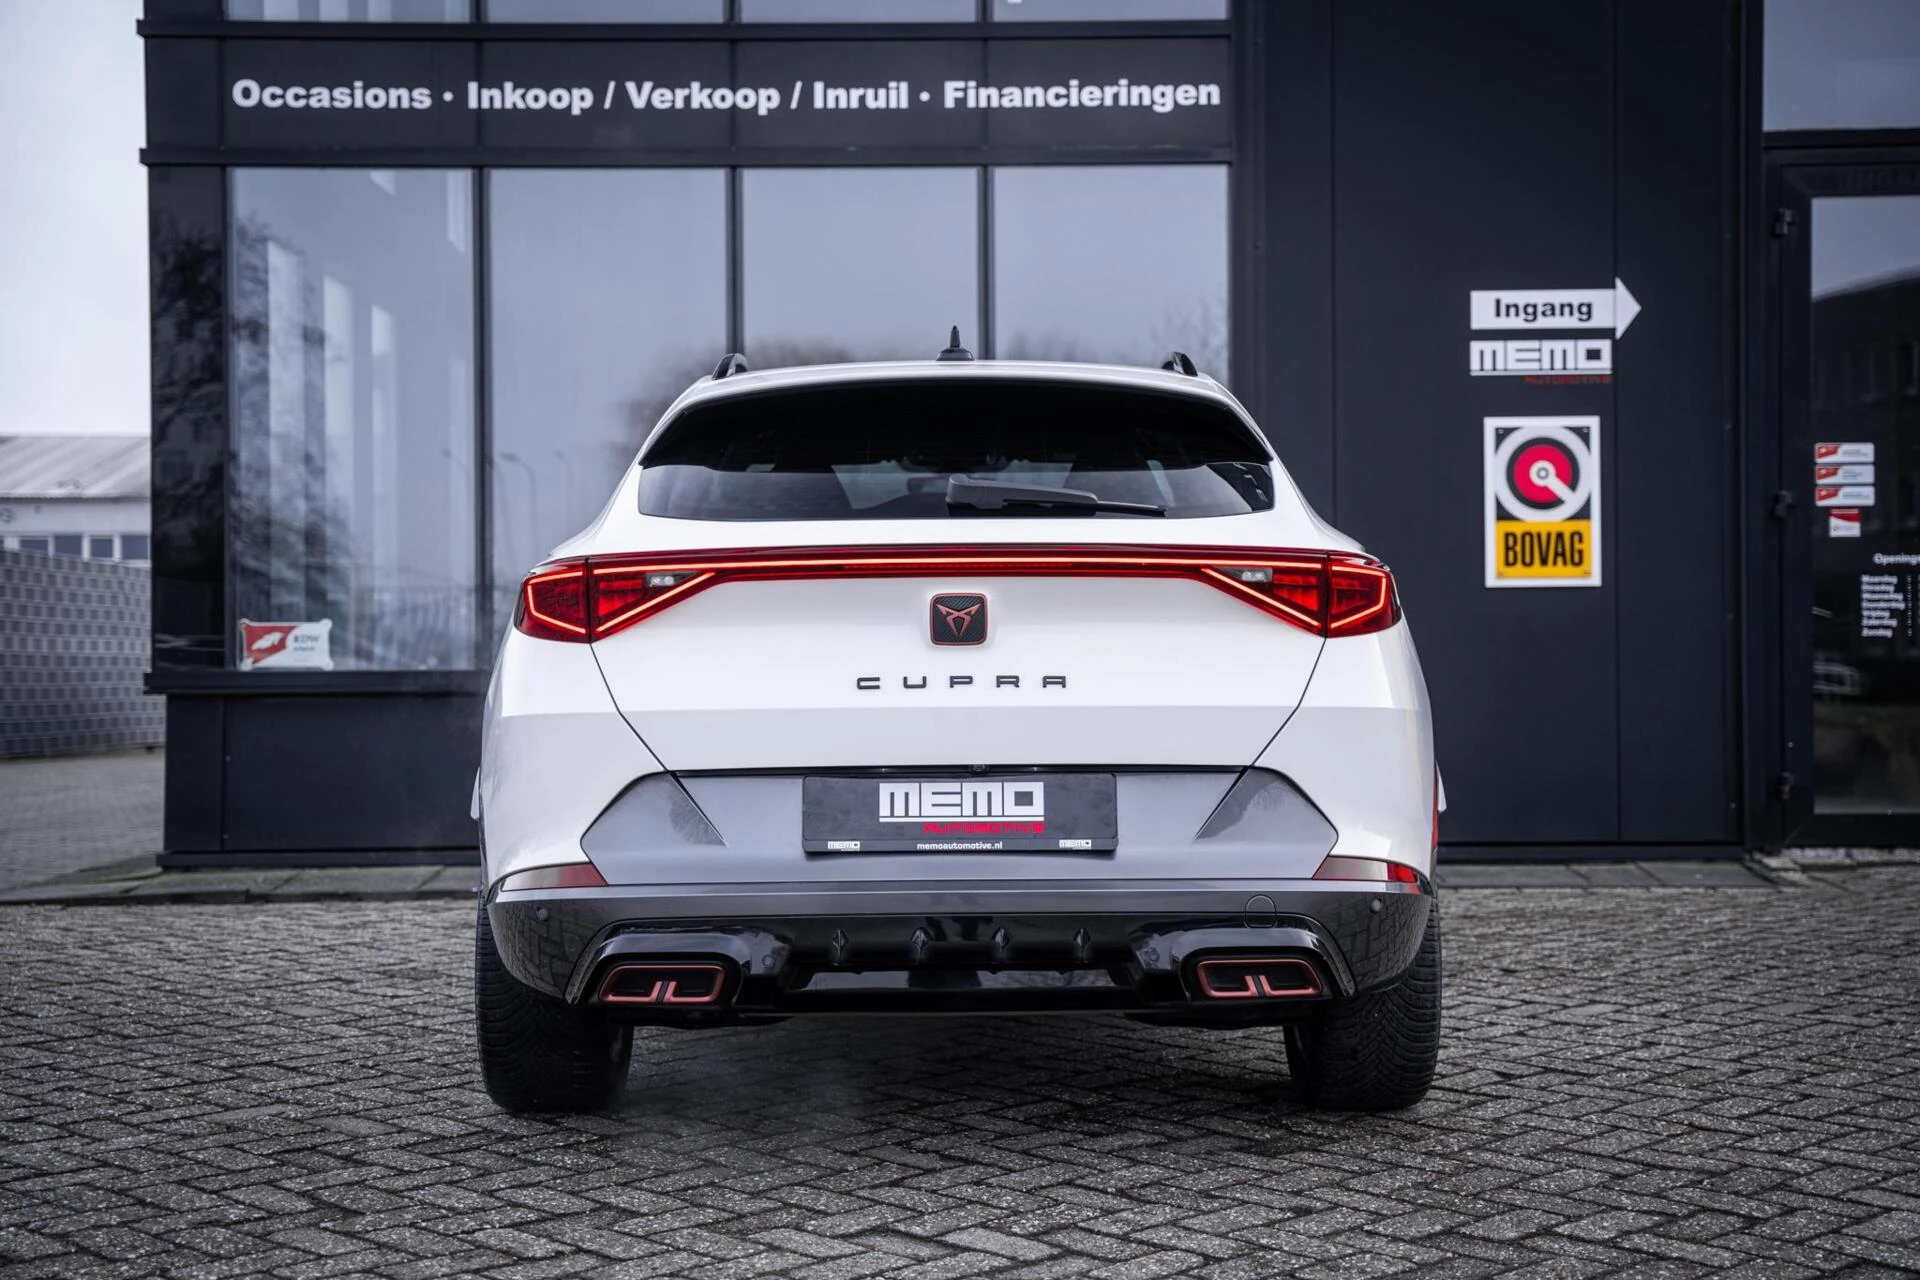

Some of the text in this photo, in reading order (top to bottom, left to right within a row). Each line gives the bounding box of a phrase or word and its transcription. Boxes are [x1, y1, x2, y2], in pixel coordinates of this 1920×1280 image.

[231, 78, 433, 110] Occasions
[467, 80, 594, 116] Inkoop
[625, 80, 781, 117] Verkoop
[813, 80, 909, 110] Inruil
[943, 77, 1221, 114] Financieringen
[1494, 298, 1593, 323] Ingang
[1469, 338, 1613, 371] MEMO
[1504, 531, 1584, 567] BOVAG
[856, 674, 1067, 690] CUPRA
[879, 782, 1045, 817] MEMO
[922, 821, 1045, 834] AUTOMOTIVE
[916, 840, 1003, 850] memoautomotive.nl
